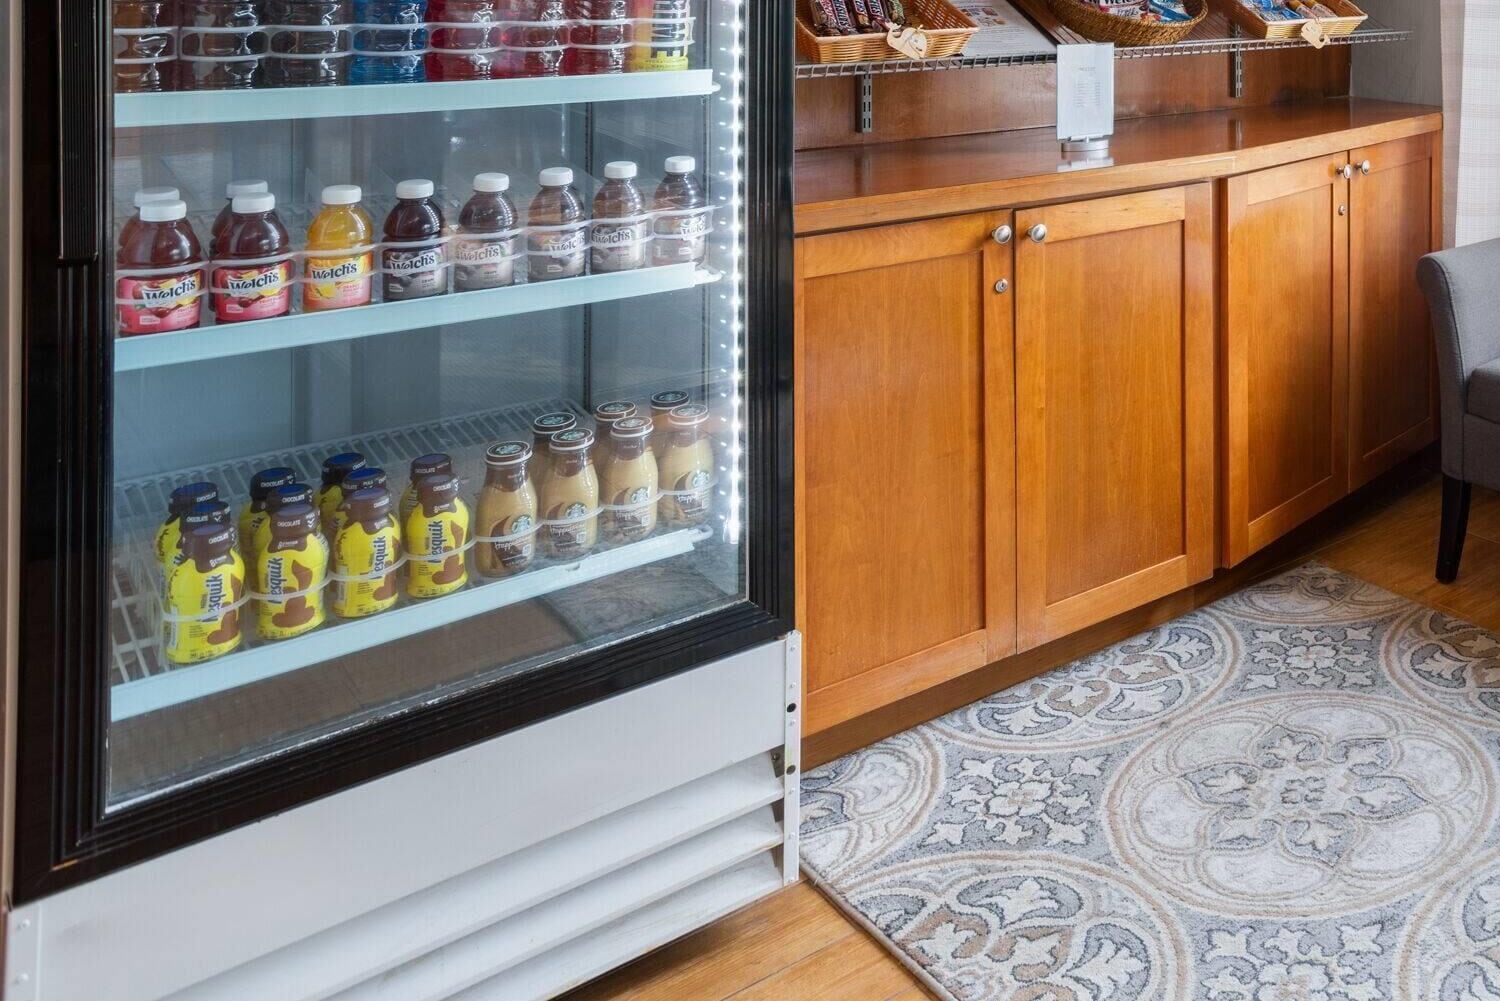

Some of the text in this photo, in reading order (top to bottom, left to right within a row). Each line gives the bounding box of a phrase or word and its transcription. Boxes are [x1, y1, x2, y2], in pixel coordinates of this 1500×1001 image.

[392, 252, 435, 270] Welch's
[459, 246, 499, 261] Welch's
[230, 270, 279, 290] Welch's
[312, 262, 358, 280] Welch's
[144, 278, 196, 300] Welch's
